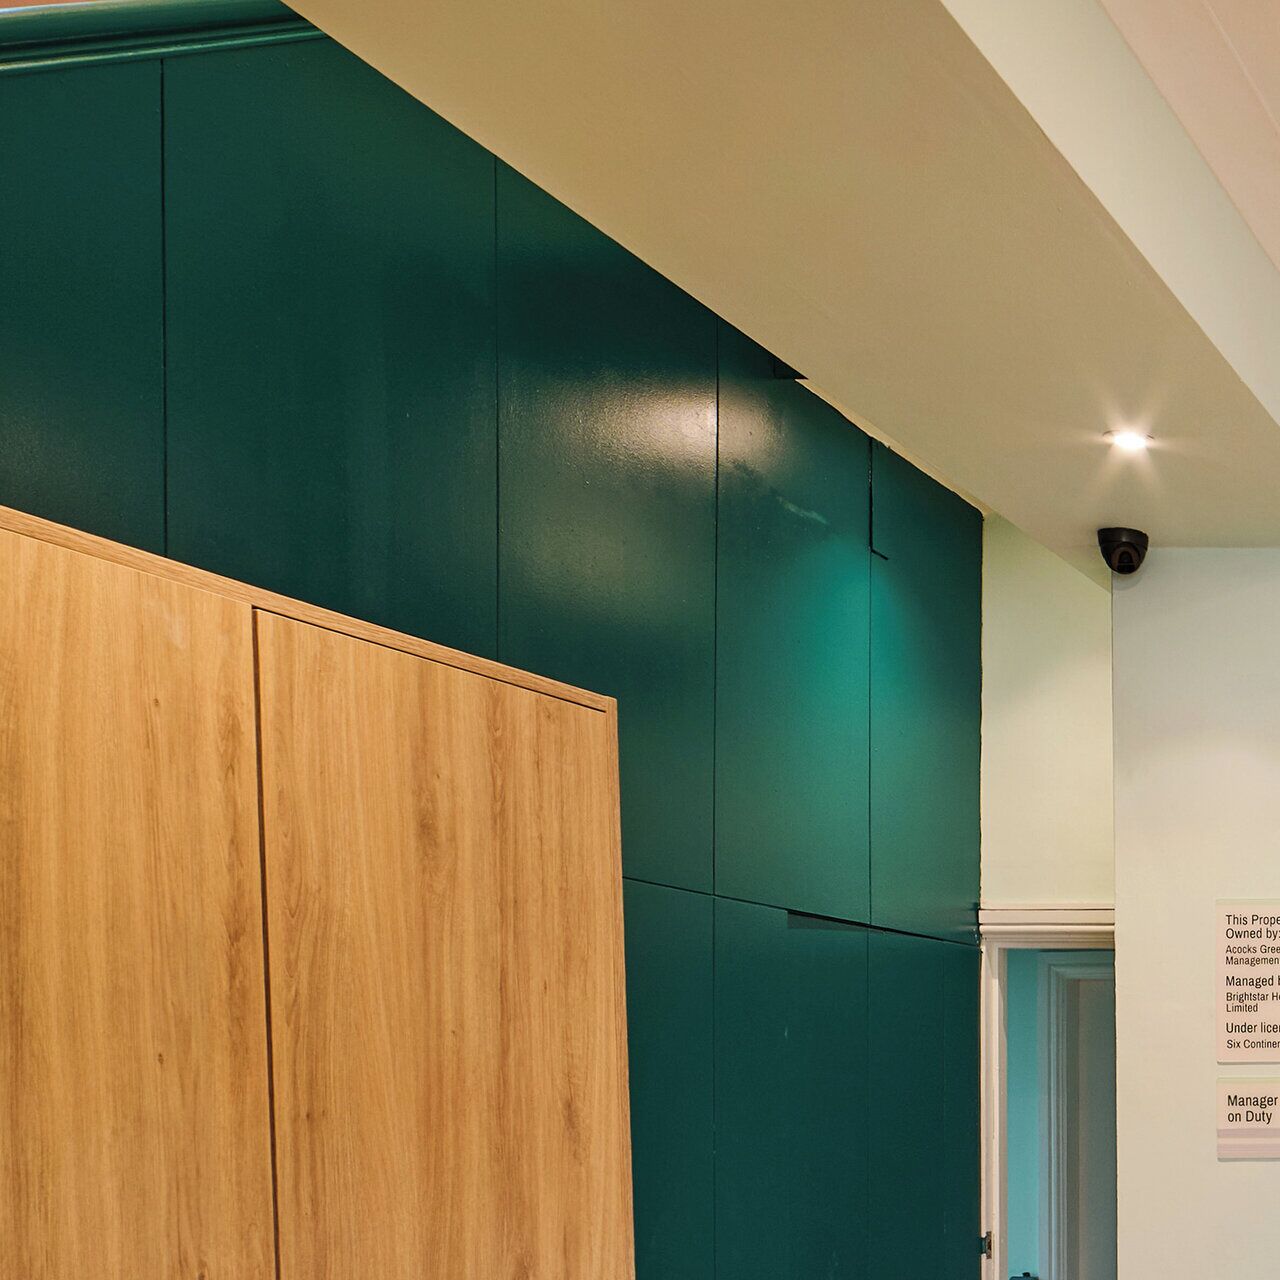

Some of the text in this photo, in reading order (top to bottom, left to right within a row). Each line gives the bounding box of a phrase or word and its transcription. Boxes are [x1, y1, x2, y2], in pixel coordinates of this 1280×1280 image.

[1225, 913, 1248, 926] This
[1225, 927, 1280, 942] Owned by:
[1225, 944, 1258, 955] Acocks
[1225, 974, 1274, 989] Managed
[1226, 991, 1269, 1004] Brightstar
[1226, 1002, 1259, 1013] Limited
[1225, 1021, 1258, 1034] Under
[1226, 1038, 1241, 1049] Six
[1227, 1094, 1279, 1110] Manager
[1227, 1110, 1273, 1125] on Duty
